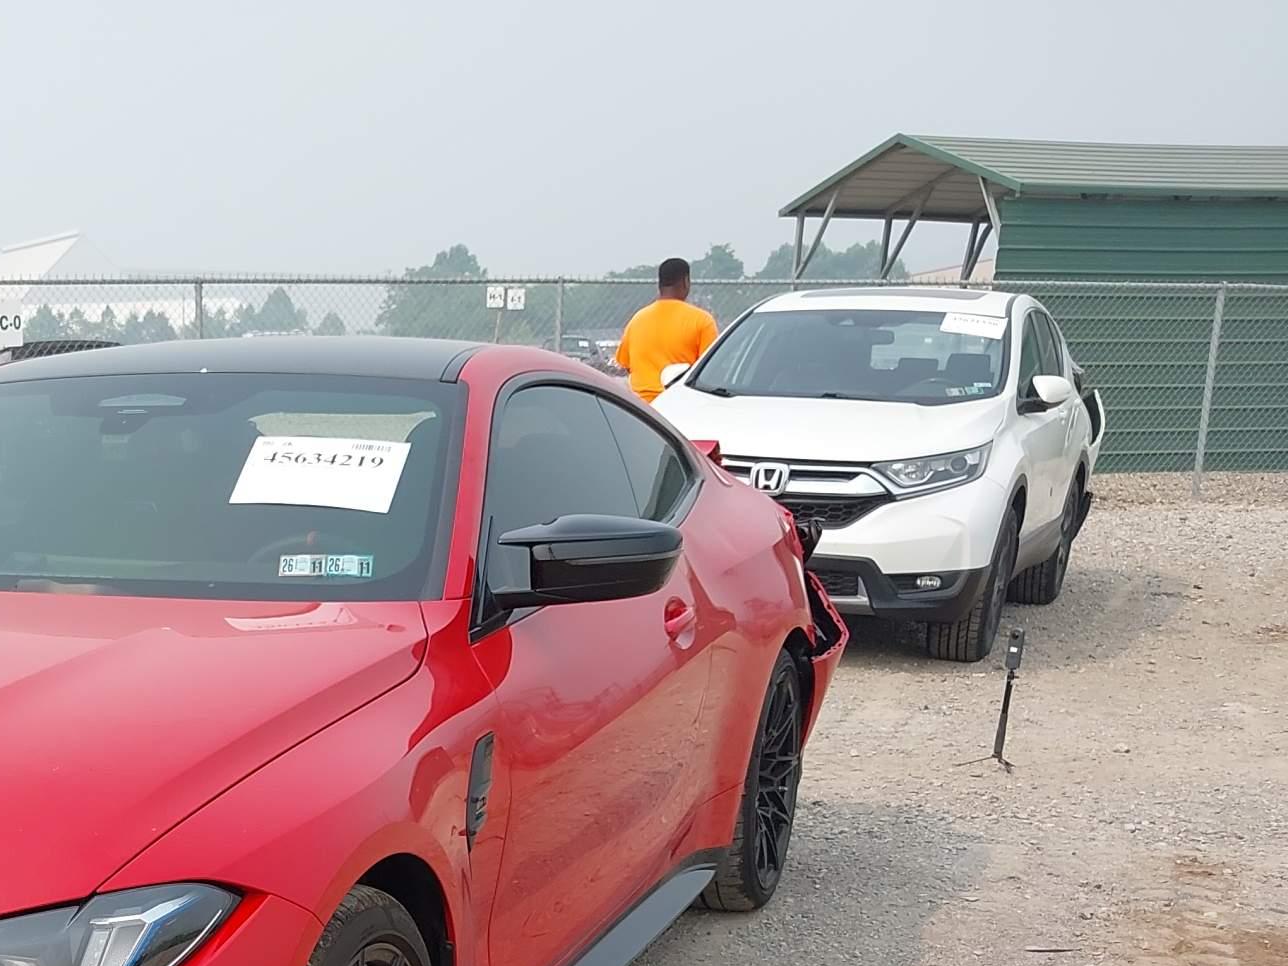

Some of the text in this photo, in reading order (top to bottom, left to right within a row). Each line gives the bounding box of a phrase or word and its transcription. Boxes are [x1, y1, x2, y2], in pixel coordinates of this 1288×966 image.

[263, 451, 385, 469] 45634219
[282, 558, 293, 573] 26
[328, 558, 340, 572] 26
